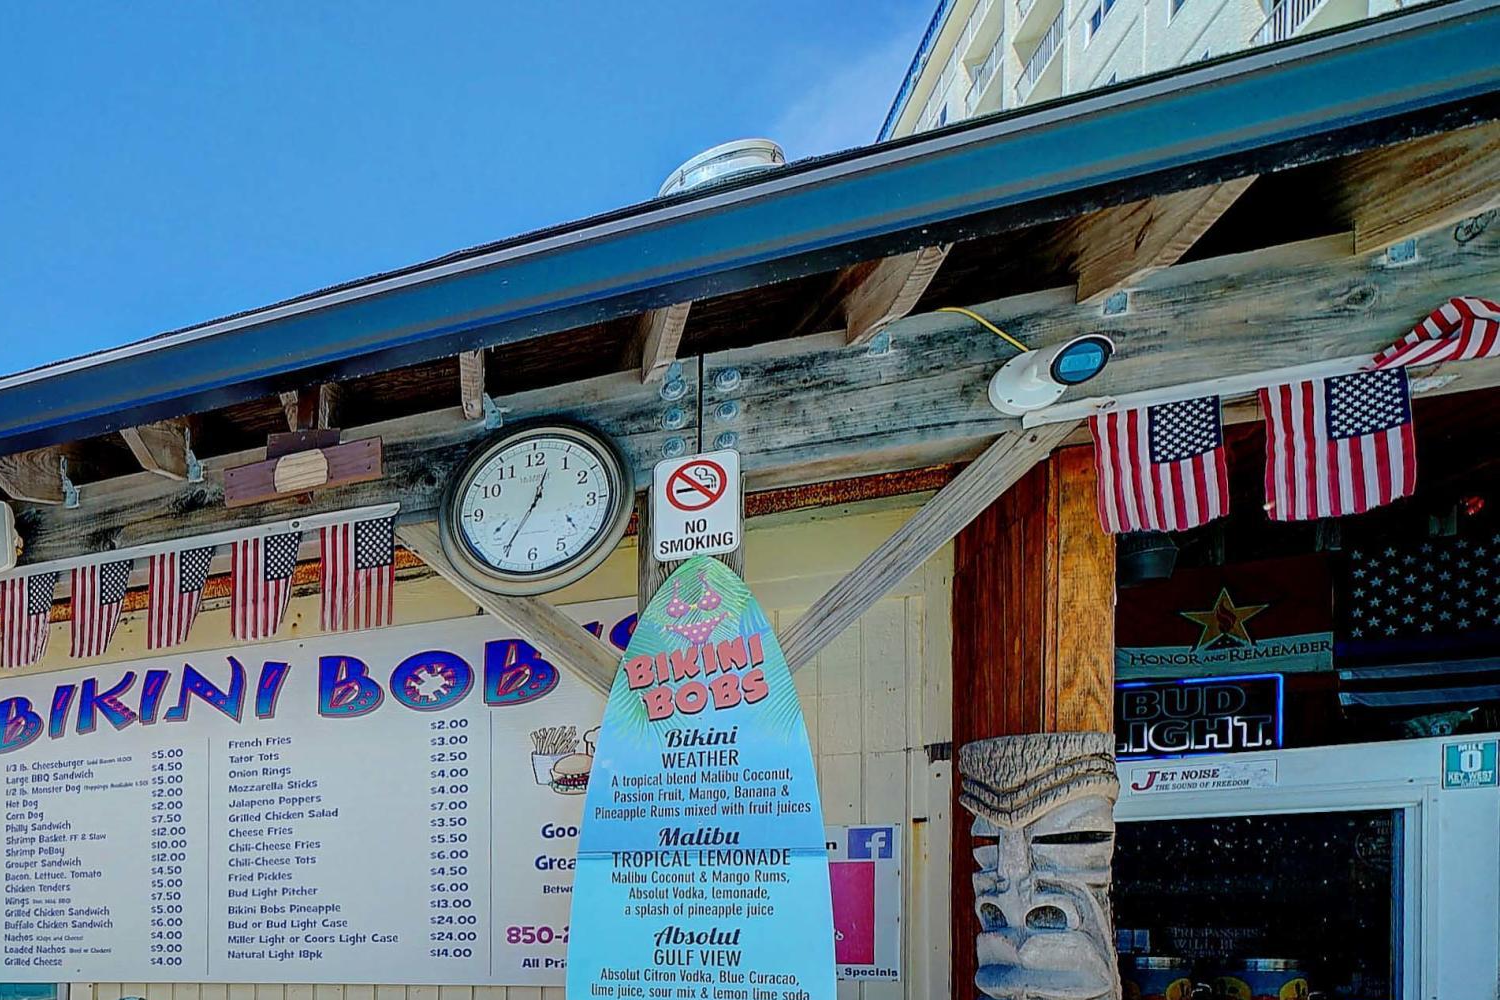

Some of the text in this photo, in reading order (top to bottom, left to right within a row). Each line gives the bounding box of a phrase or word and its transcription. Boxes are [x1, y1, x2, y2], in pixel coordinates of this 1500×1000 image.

[525, 452, 545, 467] 12
[561, 458, 569, 469] 1
[498, 466, 516, 480] 11
[577, 471, 588, 484] 2
[482, 484, 501, 498] 10
[586, 492, 596, 506] 3
[474, 509, 484, 522] 9
[685, 519, 707, 534] NO
[556, 538, 566, 551] 5
[660, 531, 733, 554] SMOKING
[528, 548, 538, 560] 6
[1130, 640, 1333, 666] HONOR AND REMEMBER
[623, 632, 764, 691] BIKINI
[643, 668, 769, 722] BOBS
[1123, 685, 1246, 720] BUD
[430, 719, 468, 730] $2.00
[229, 736, 291, 749] French Fries
[665, 726, 738, 748] Bikini
[1458, 743, 1484, 751] MILE
[662, 750, 739, 769] WEATHER
[152, 762, 182, 772] $4.50
[6, 769, 93, 786] Large BBQ Sandwich
[612, 767, 793, 789] A tropical blend Malibu Coconut,
[1181, 769, 1220, 780] NOISE
[1448, 771, 1492, 782] KEY WEST
[1212, 779, 1249, 787] FREEDOM
[430, 800, 467, 812] $7.00
[229, 808, 338, 823] Grilled Chicken Salad
[151, 827, 186, 837] $12.00
[659, 827, 740, 846] Malibu
[612, 849, 791, 868] TROPICAL LEMONADE
[228, 887, 318, 900] Bud Light Pitcher
[228, 903, 341, 915] Bikini Bobs Pineapple
[430, 899, 471, 909] $13.00
[5, 919, 113, 930] Buffalo Chicken Sandwich
[151, 918, 183, 927] $6.00
[228, 934, 398, 945] Miller Light or Coors Light Case
[430, 931, 476, 942] $24.00
[654, 926, 741, 947] Absolut
[5, 958, 62, 966] Grilled Cheese
[150, 957, 182, 966] $4.00
[522, 958, 539, 968] All
[654, 949, 741, 966] GULF VIEW
[845, 966, 898, 978] Specials
